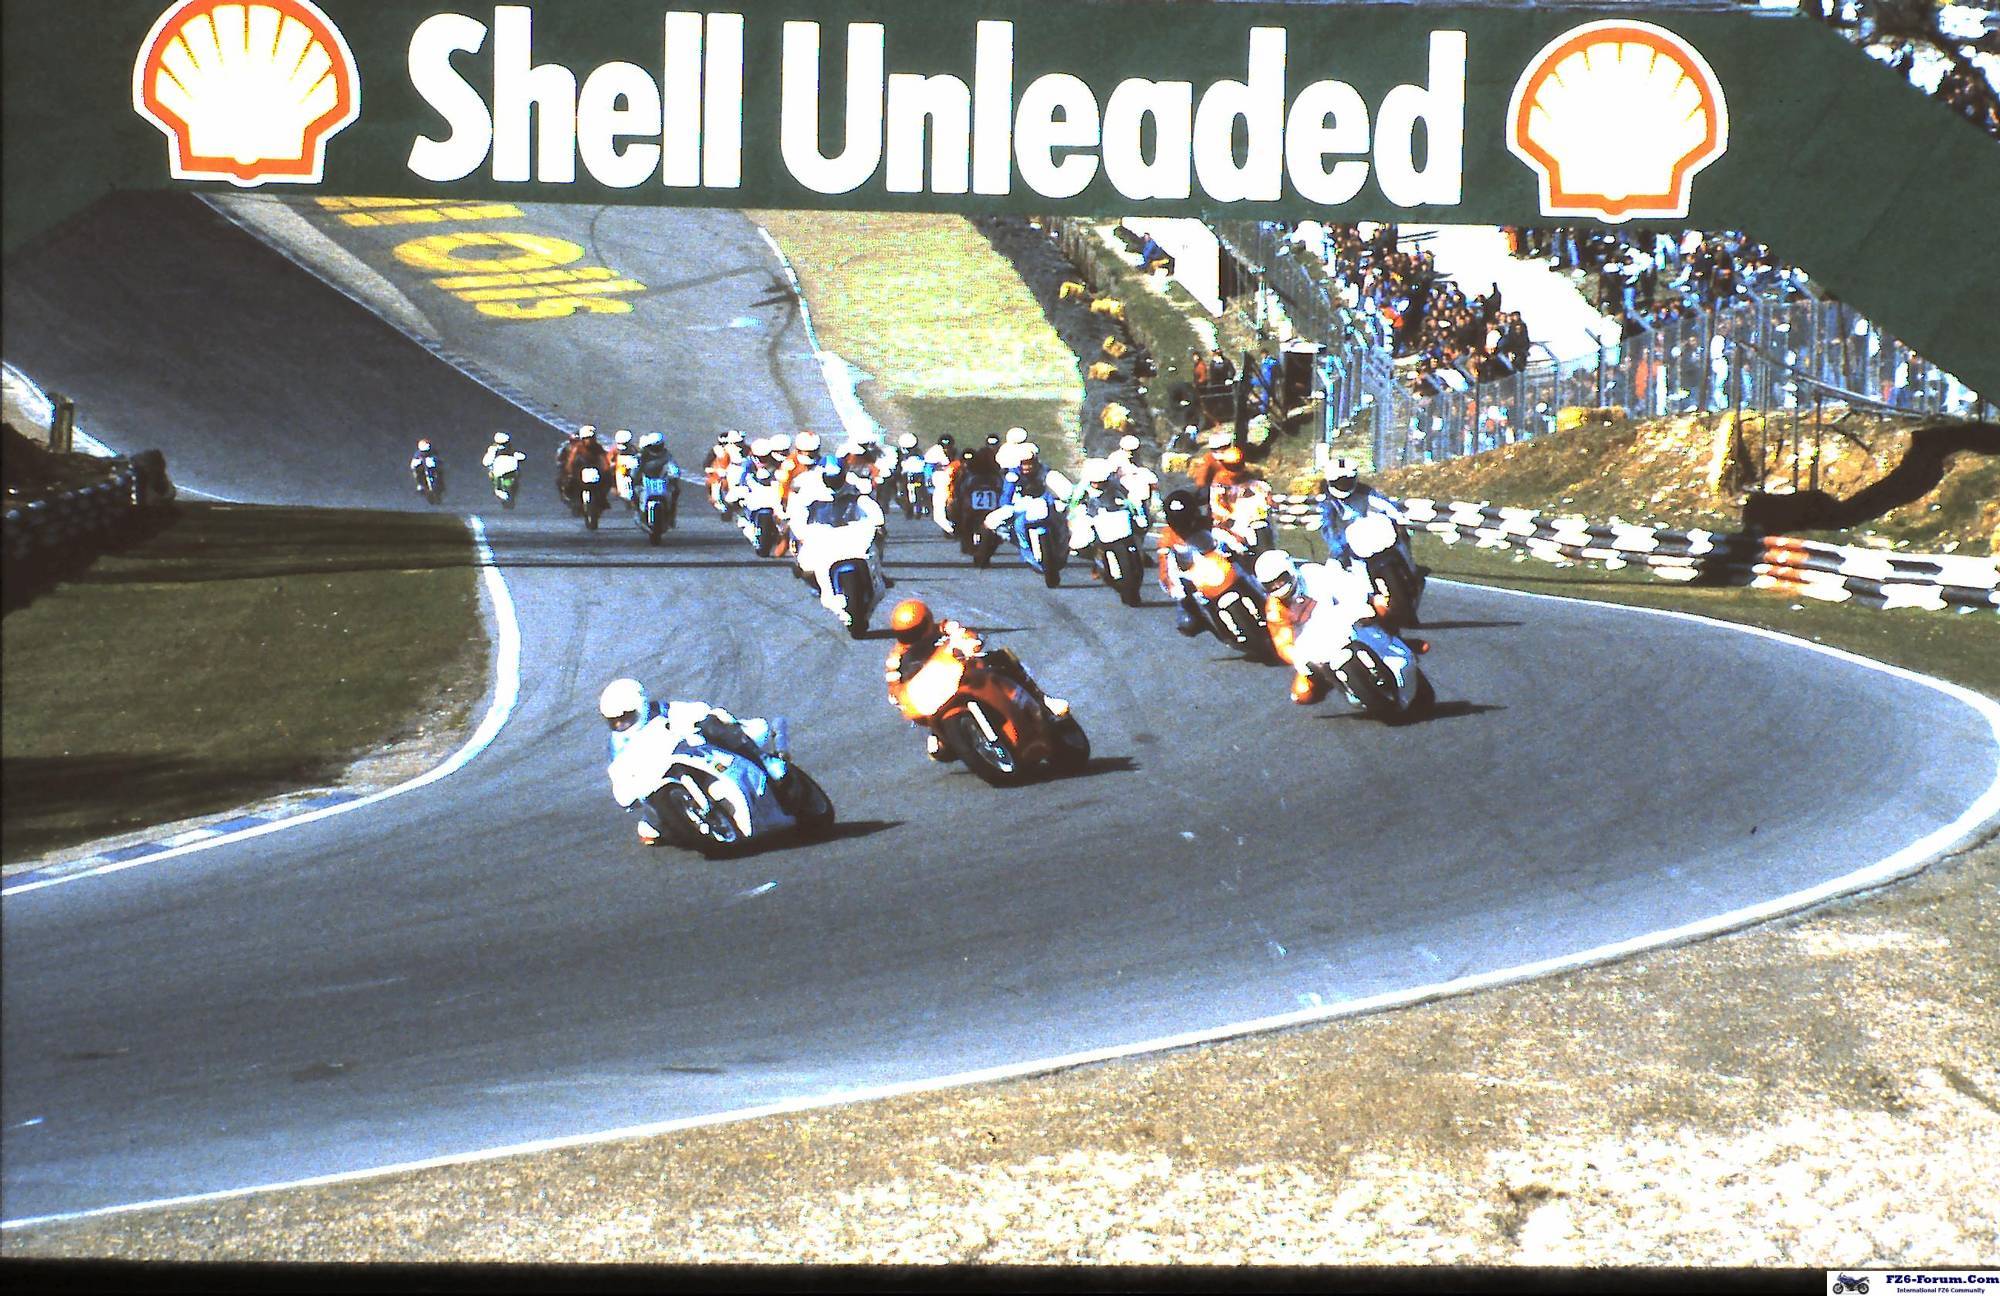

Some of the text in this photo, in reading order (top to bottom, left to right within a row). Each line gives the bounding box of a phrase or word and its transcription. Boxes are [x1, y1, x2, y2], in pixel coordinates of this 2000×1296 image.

[408, 6, 1466, 206] Shell Unleaded
[975, 491, 993, 507] 21
